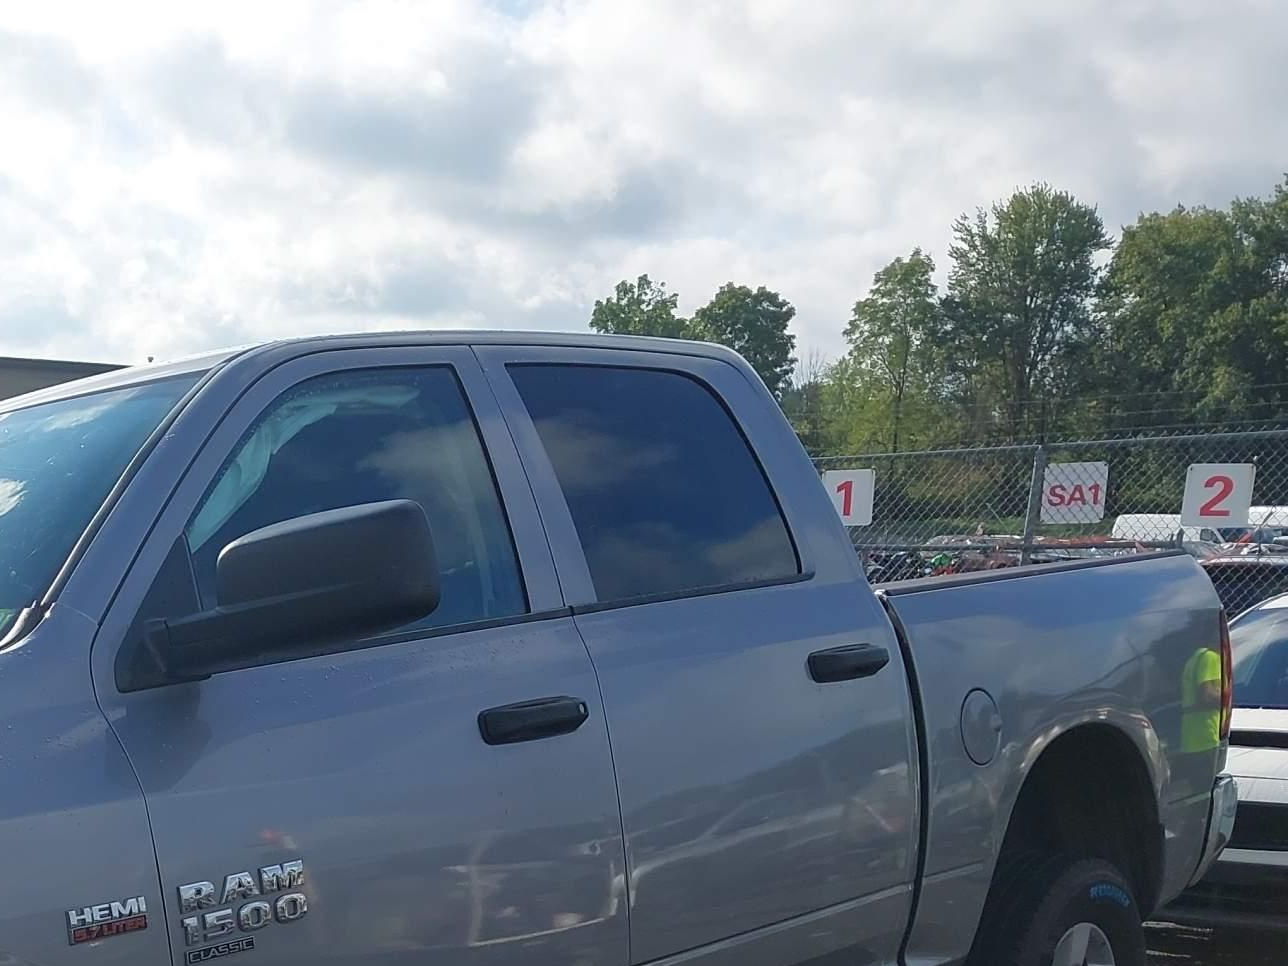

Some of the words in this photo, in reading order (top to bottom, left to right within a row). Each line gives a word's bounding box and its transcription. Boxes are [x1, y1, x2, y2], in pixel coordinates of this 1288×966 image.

[836, 480, 854, 517] 1
[1047, 482, 1100, 507] SA1
[1199, 475, 1234, 517] 2
[176, 858, 305, 915] RAM
[66, 895, 147, 927] HEMI
[102, 915, 147, 937] LITER
[181, 892, 308, 946] 1500
[188, 939, 255, 963] CLASSIC
